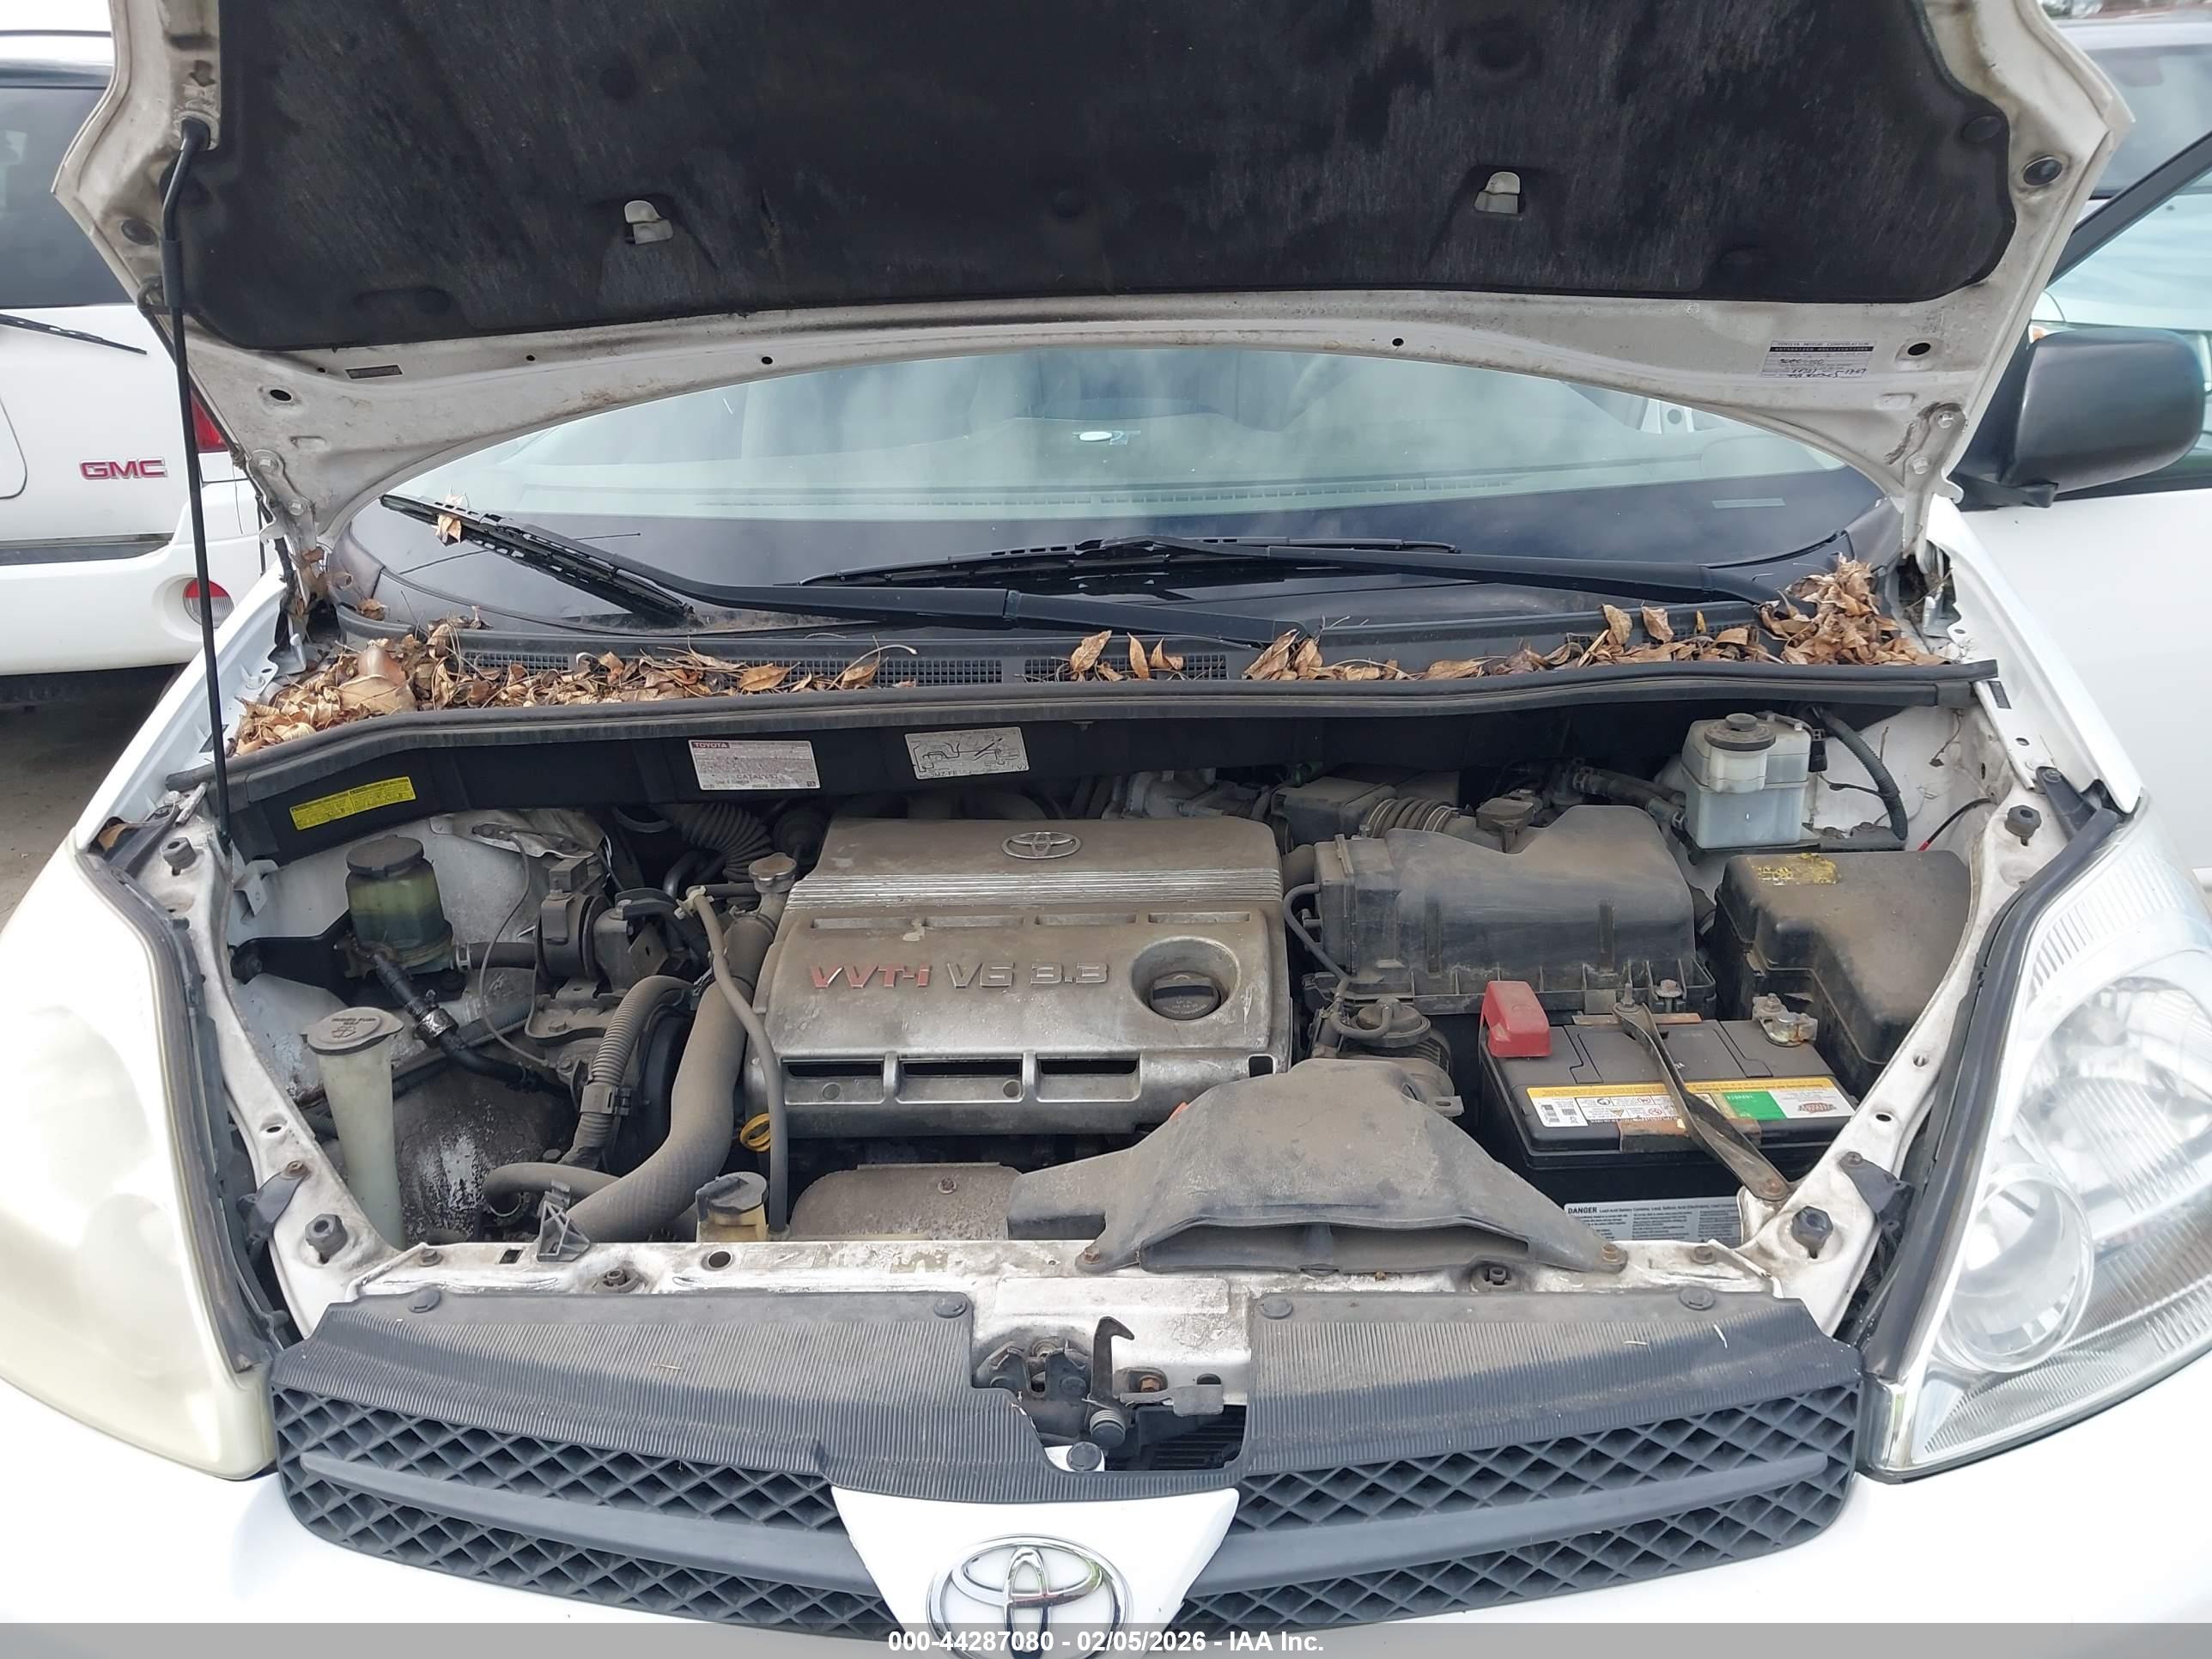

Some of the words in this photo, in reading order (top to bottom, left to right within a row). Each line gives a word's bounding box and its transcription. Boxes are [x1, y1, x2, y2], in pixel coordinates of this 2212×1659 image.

[80, 458, 168, 480] GMC
[946, 961, 1015, 988] V6
[1030, 961, 1109, 986] 3.3
